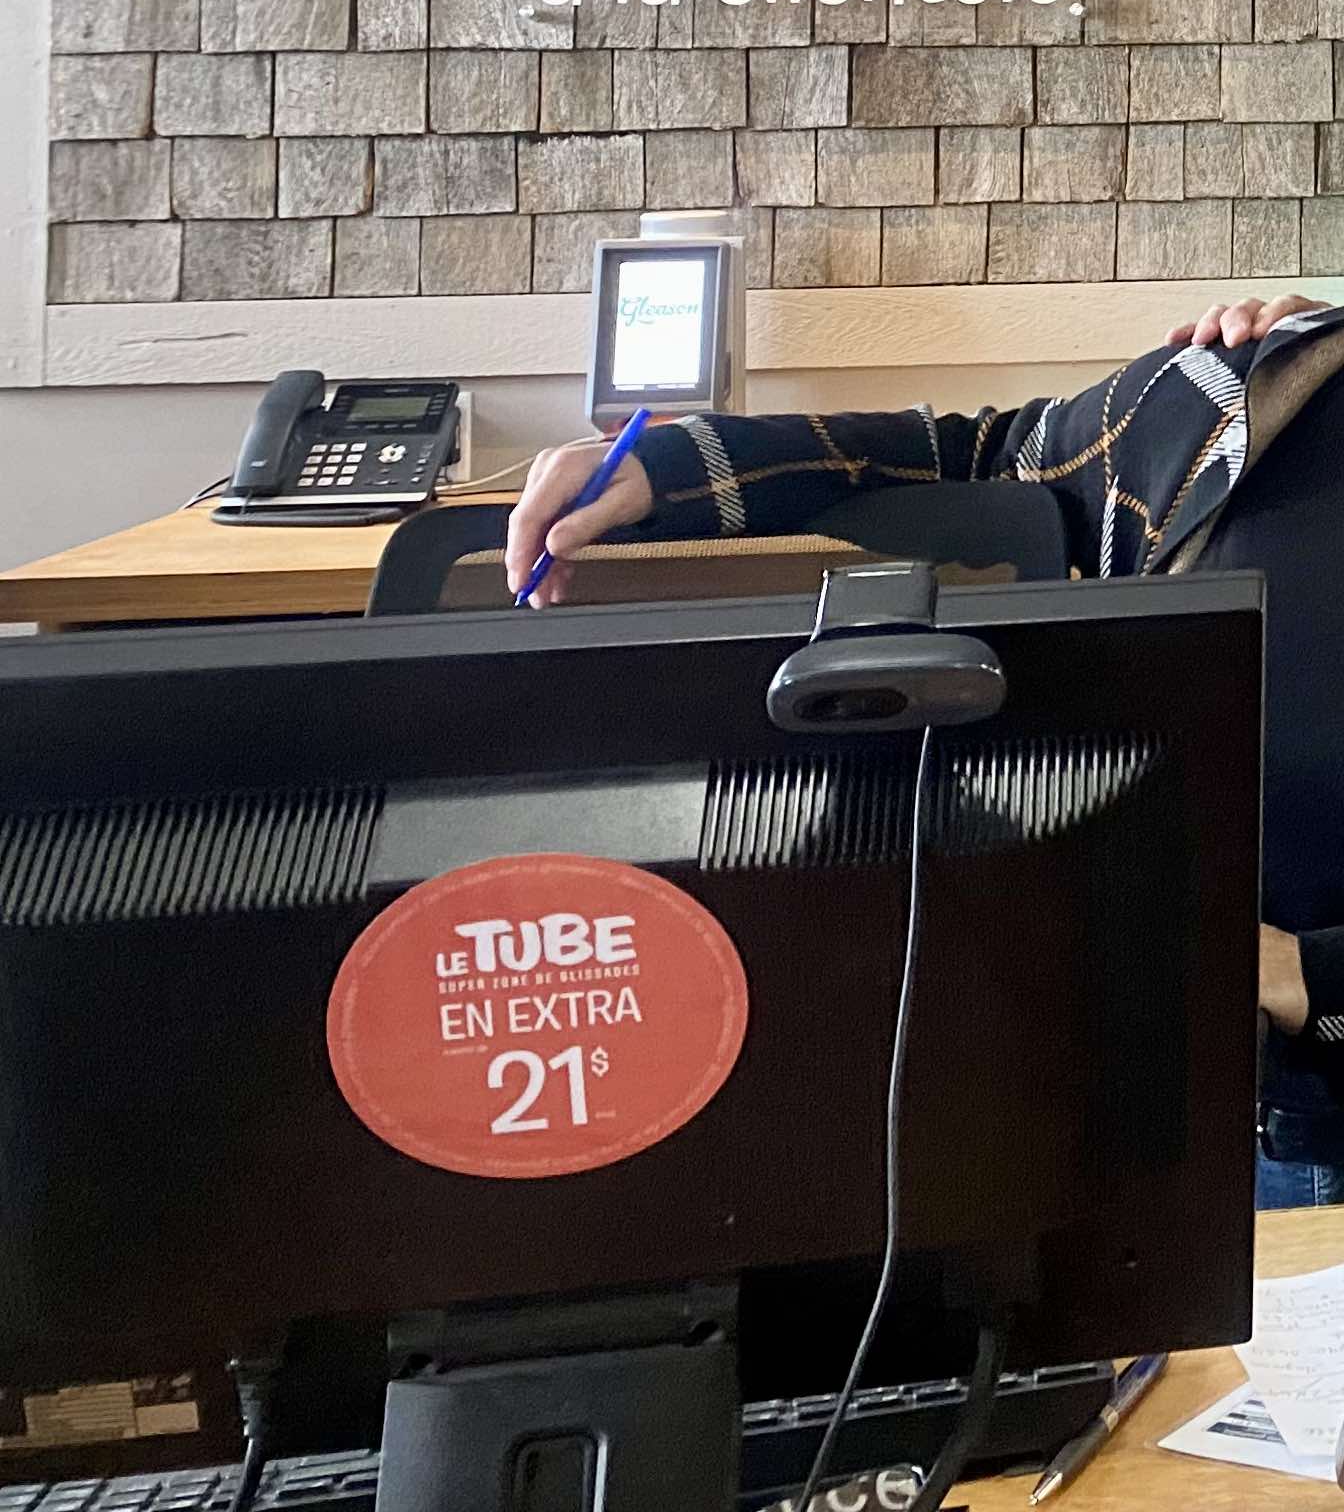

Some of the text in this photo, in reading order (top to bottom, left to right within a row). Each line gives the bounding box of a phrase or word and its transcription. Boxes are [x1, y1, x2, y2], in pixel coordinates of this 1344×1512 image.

[436, 912, 638, 978] LE TUBE
[439, 985, 643, 1042] EN EXTRA
